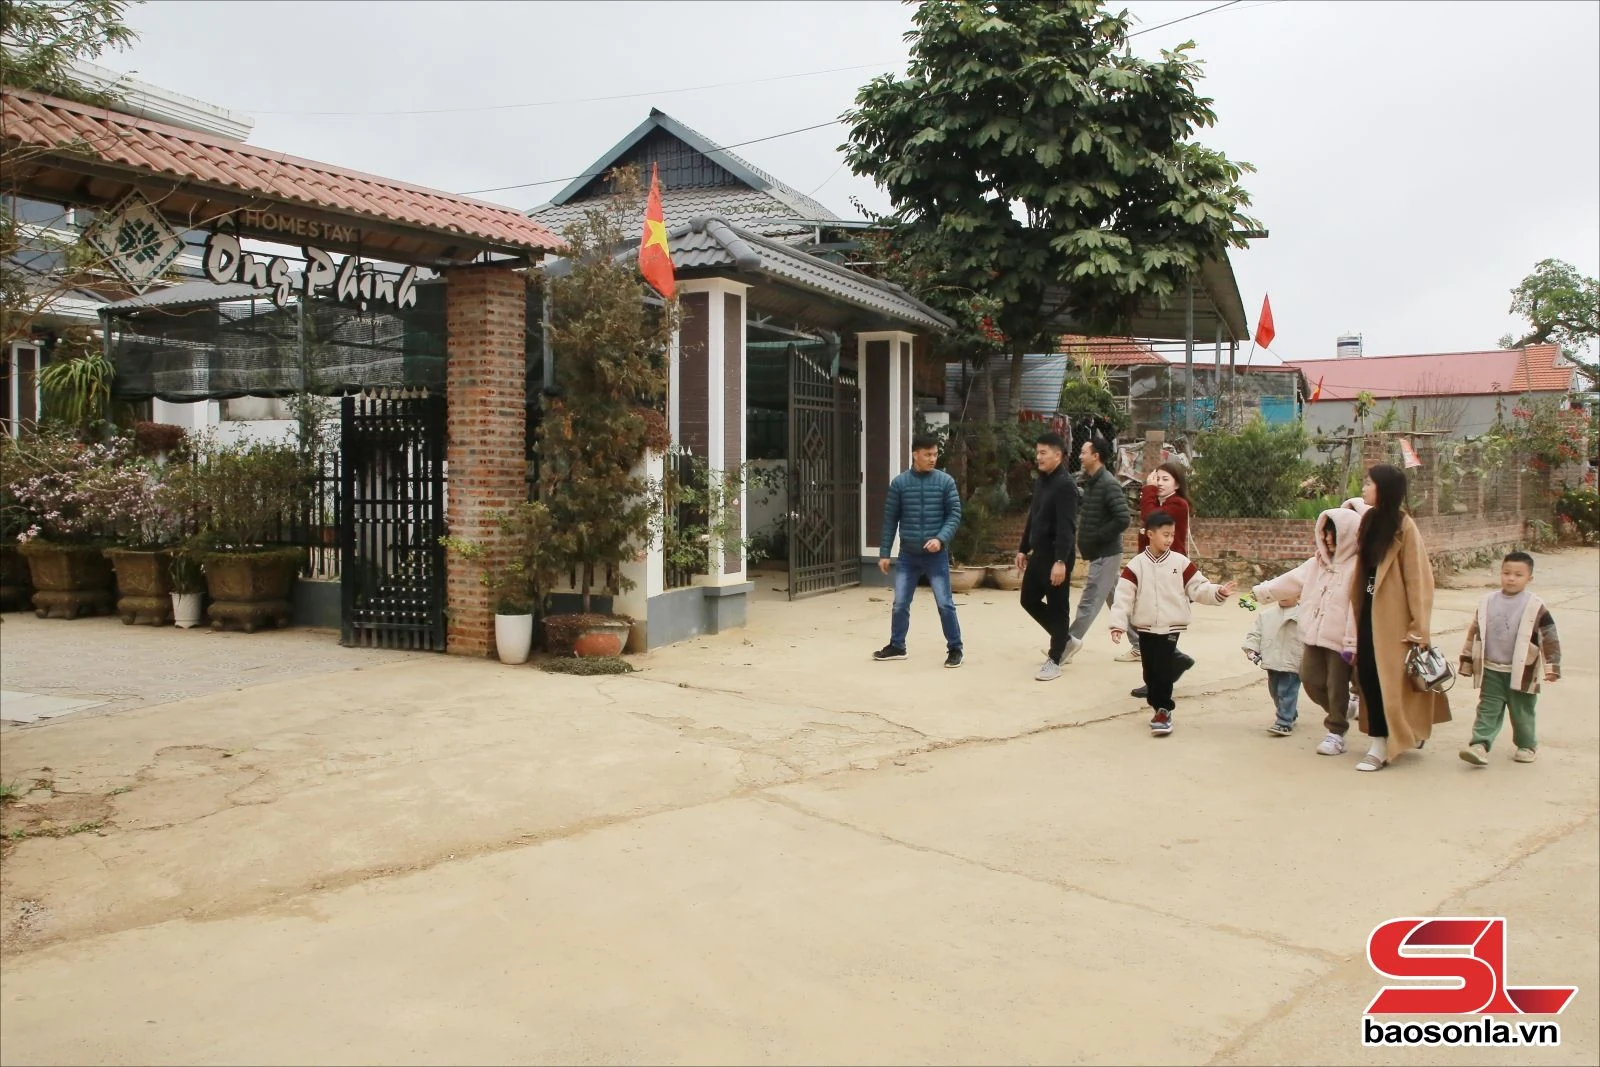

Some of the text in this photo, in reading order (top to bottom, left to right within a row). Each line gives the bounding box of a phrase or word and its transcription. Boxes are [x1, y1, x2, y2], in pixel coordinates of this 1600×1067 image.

[246, 210, 353, 243] HOMESTAY
[205, 213, 417, 312] Ông Phịnh
